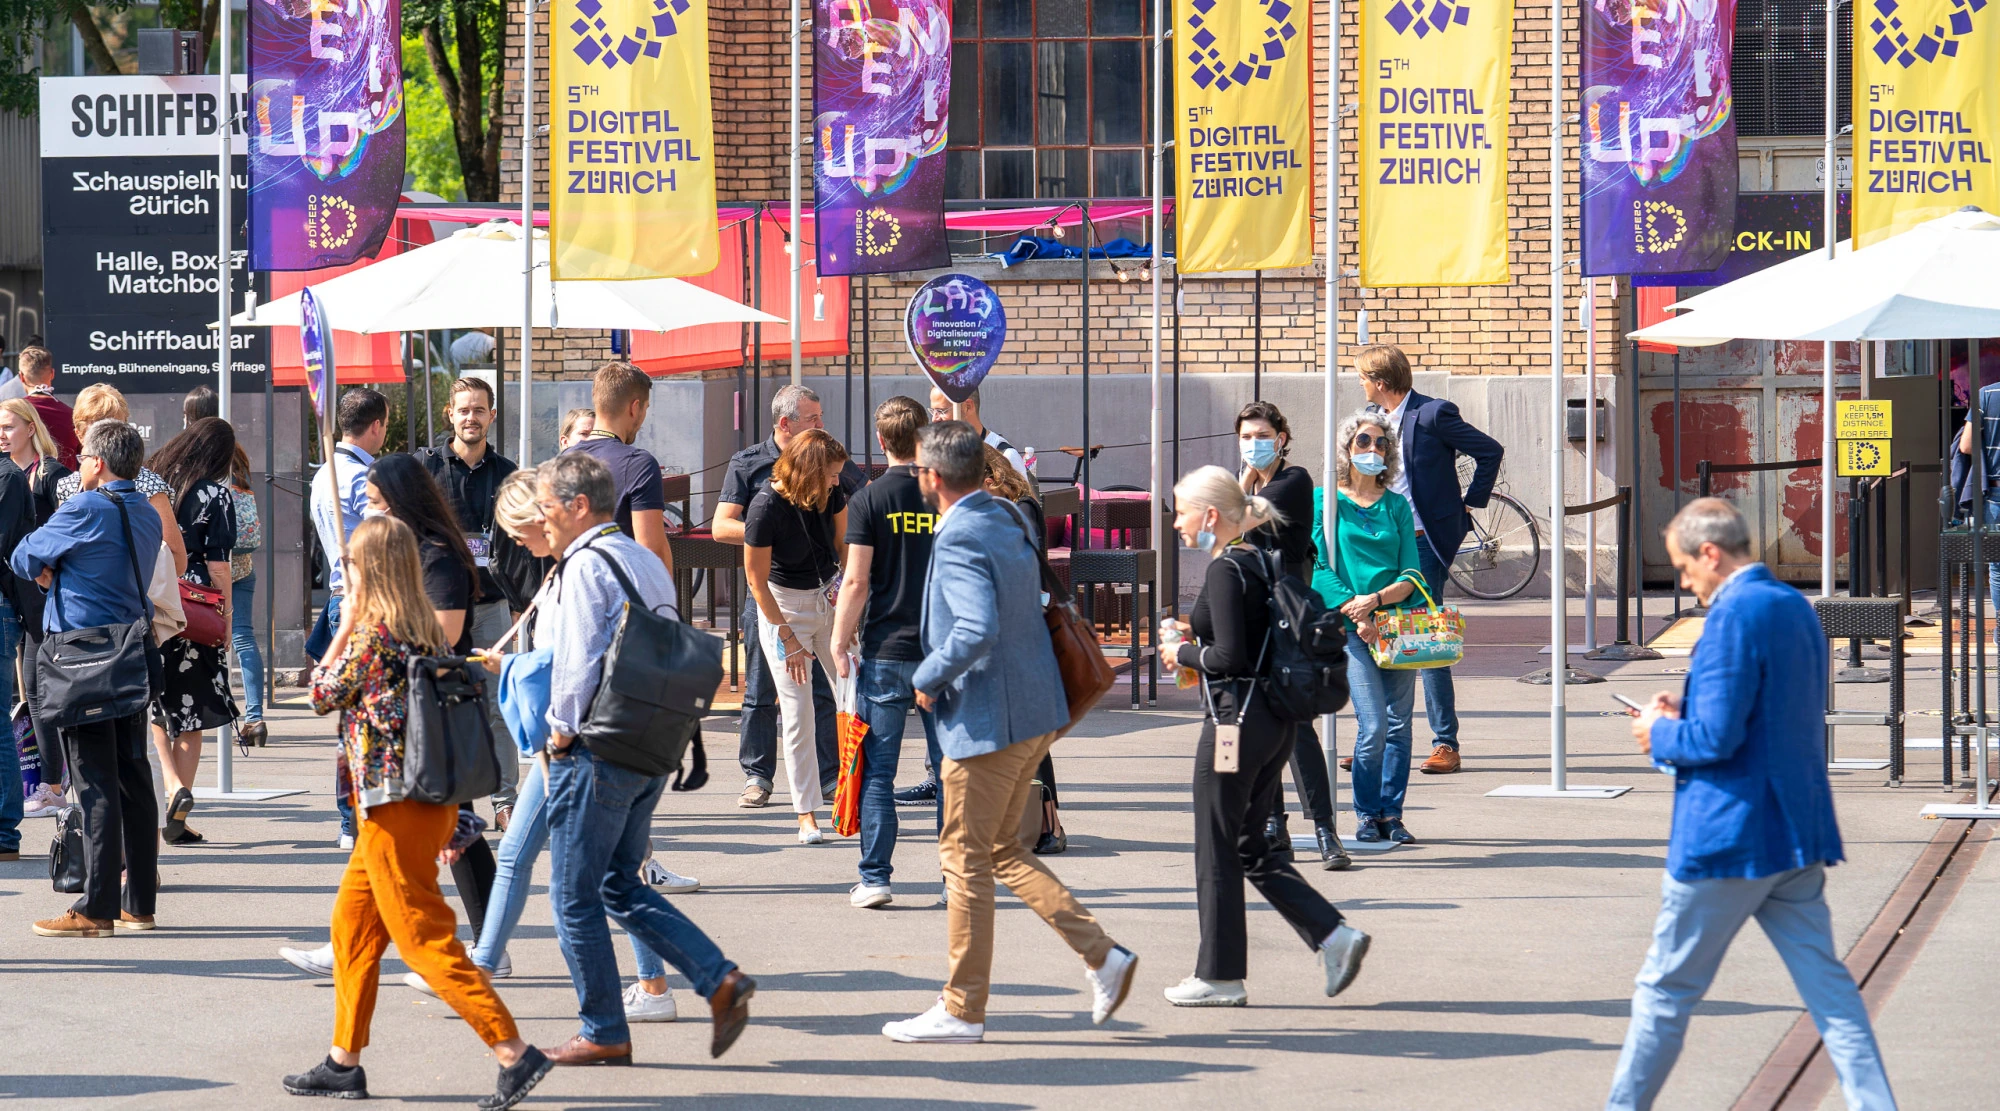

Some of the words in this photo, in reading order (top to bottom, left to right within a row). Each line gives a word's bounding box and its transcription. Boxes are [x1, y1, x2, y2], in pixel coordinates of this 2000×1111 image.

[1379, 58, 1410, 79] 5TH
[568, 85, 599, 103] 5TH
[1379, 87, 1484, 115] DIGITAL
[1869, 84, 1895, 102] 5TH
[568, 110, 680, 134] DIGITAL
[1188, 106, 1213, 122] 5TH
[1869, 109, 1972, 134] DIGITAL
[1189, 125, 1286, 147] DIGITAL
[1379, 123, 1492, 149] FESTIVAL
[568, 139, 701, 164] FESTIVAL
[1190, 149, 1303, 173] FESTIVAL
[1869, 139, 1992, 164] FESTIVAL
[568, 169, 677, 194] ZÜRICH
[1379, 157, 1481, 185] ZÜRICH
[1868, 169, 1973, 194] ZÜRICH
[1192, 175, 1283, 199] ZÜRICH
[96, 251, 165, 275] Halle,
[171, 251, 218, 271] Box
[108, 273, 234, 294] Matchbo
[927, 329, 987, 339] Digitalisierung
[932, 319, 976, 328] Innovation
[943, 339, 951, 347] in
[953, 339, 971, 347] KMU
[61, 364, 117, 376] Empfang,
[118, 362, 210, 374] Bühneneingang,
[211, 362, 266, 373] Sfflage
[1849, 404, 1879, 412] PLEASE
